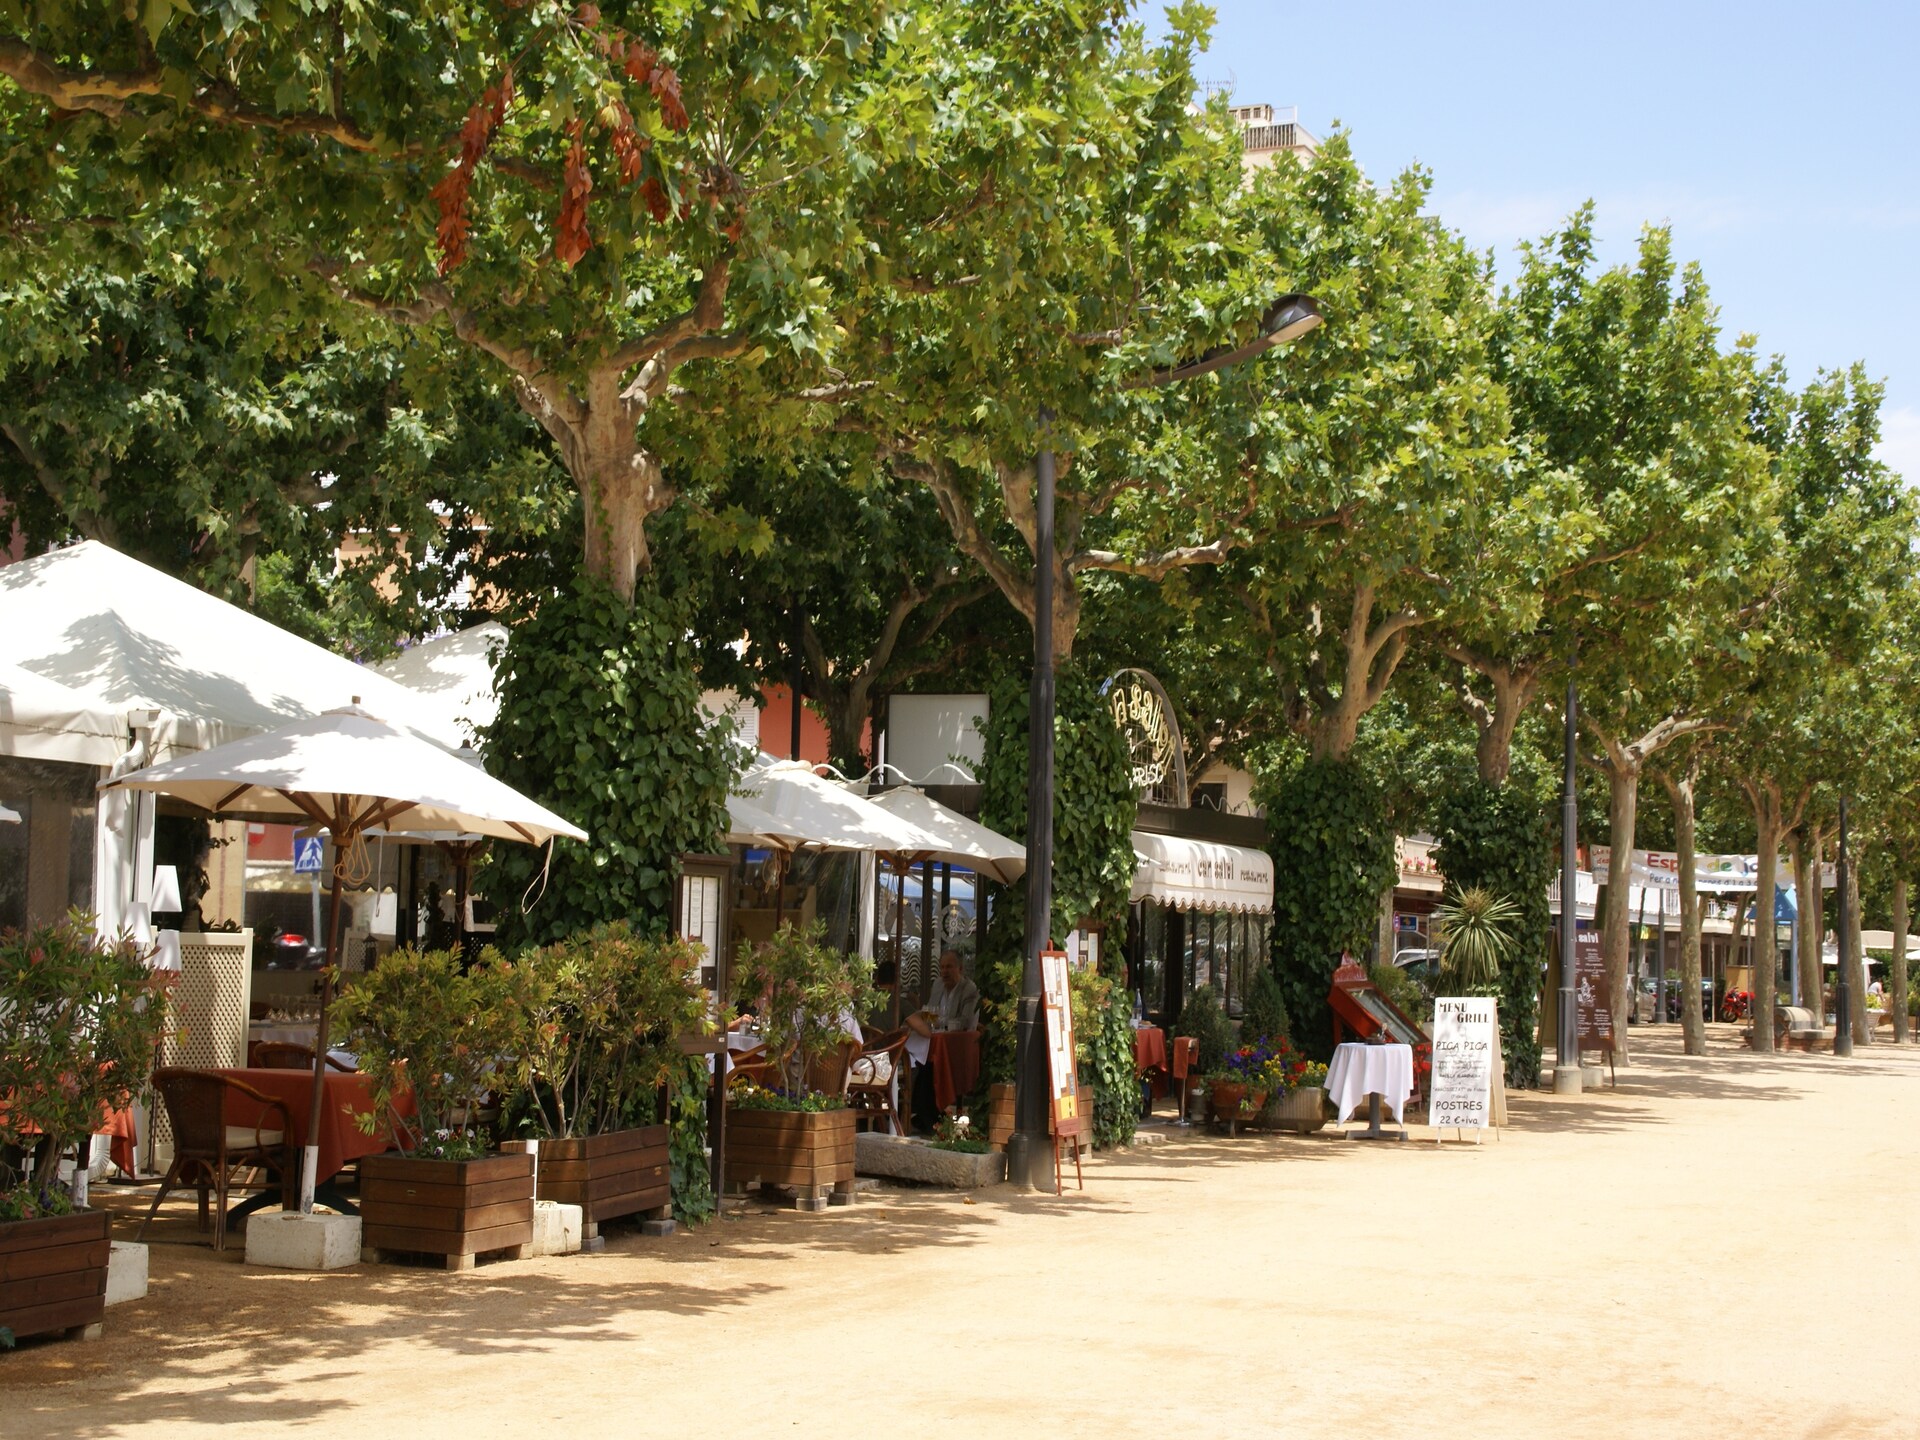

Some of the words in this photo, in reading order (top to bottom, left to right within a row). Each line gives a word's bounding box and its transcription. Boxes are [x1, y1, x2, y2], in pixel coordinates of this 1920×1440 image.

[1706, 858, 1732, 872] de
[1649, 873, 1663, 884] Per
[1439, 1002, 1467, 1012] MENU
[1457, 1013, 1489, 1023] GRILL
[1435, 1041, 1459, 1051] PICA
[1464, 1041, 1488, 1051] PICA
[1435, 1101, 1483, 1111] POSTRES
[1440, 1115, 1451, 1124] 22
[1454, 1115, 1478, 1124] €+iva
